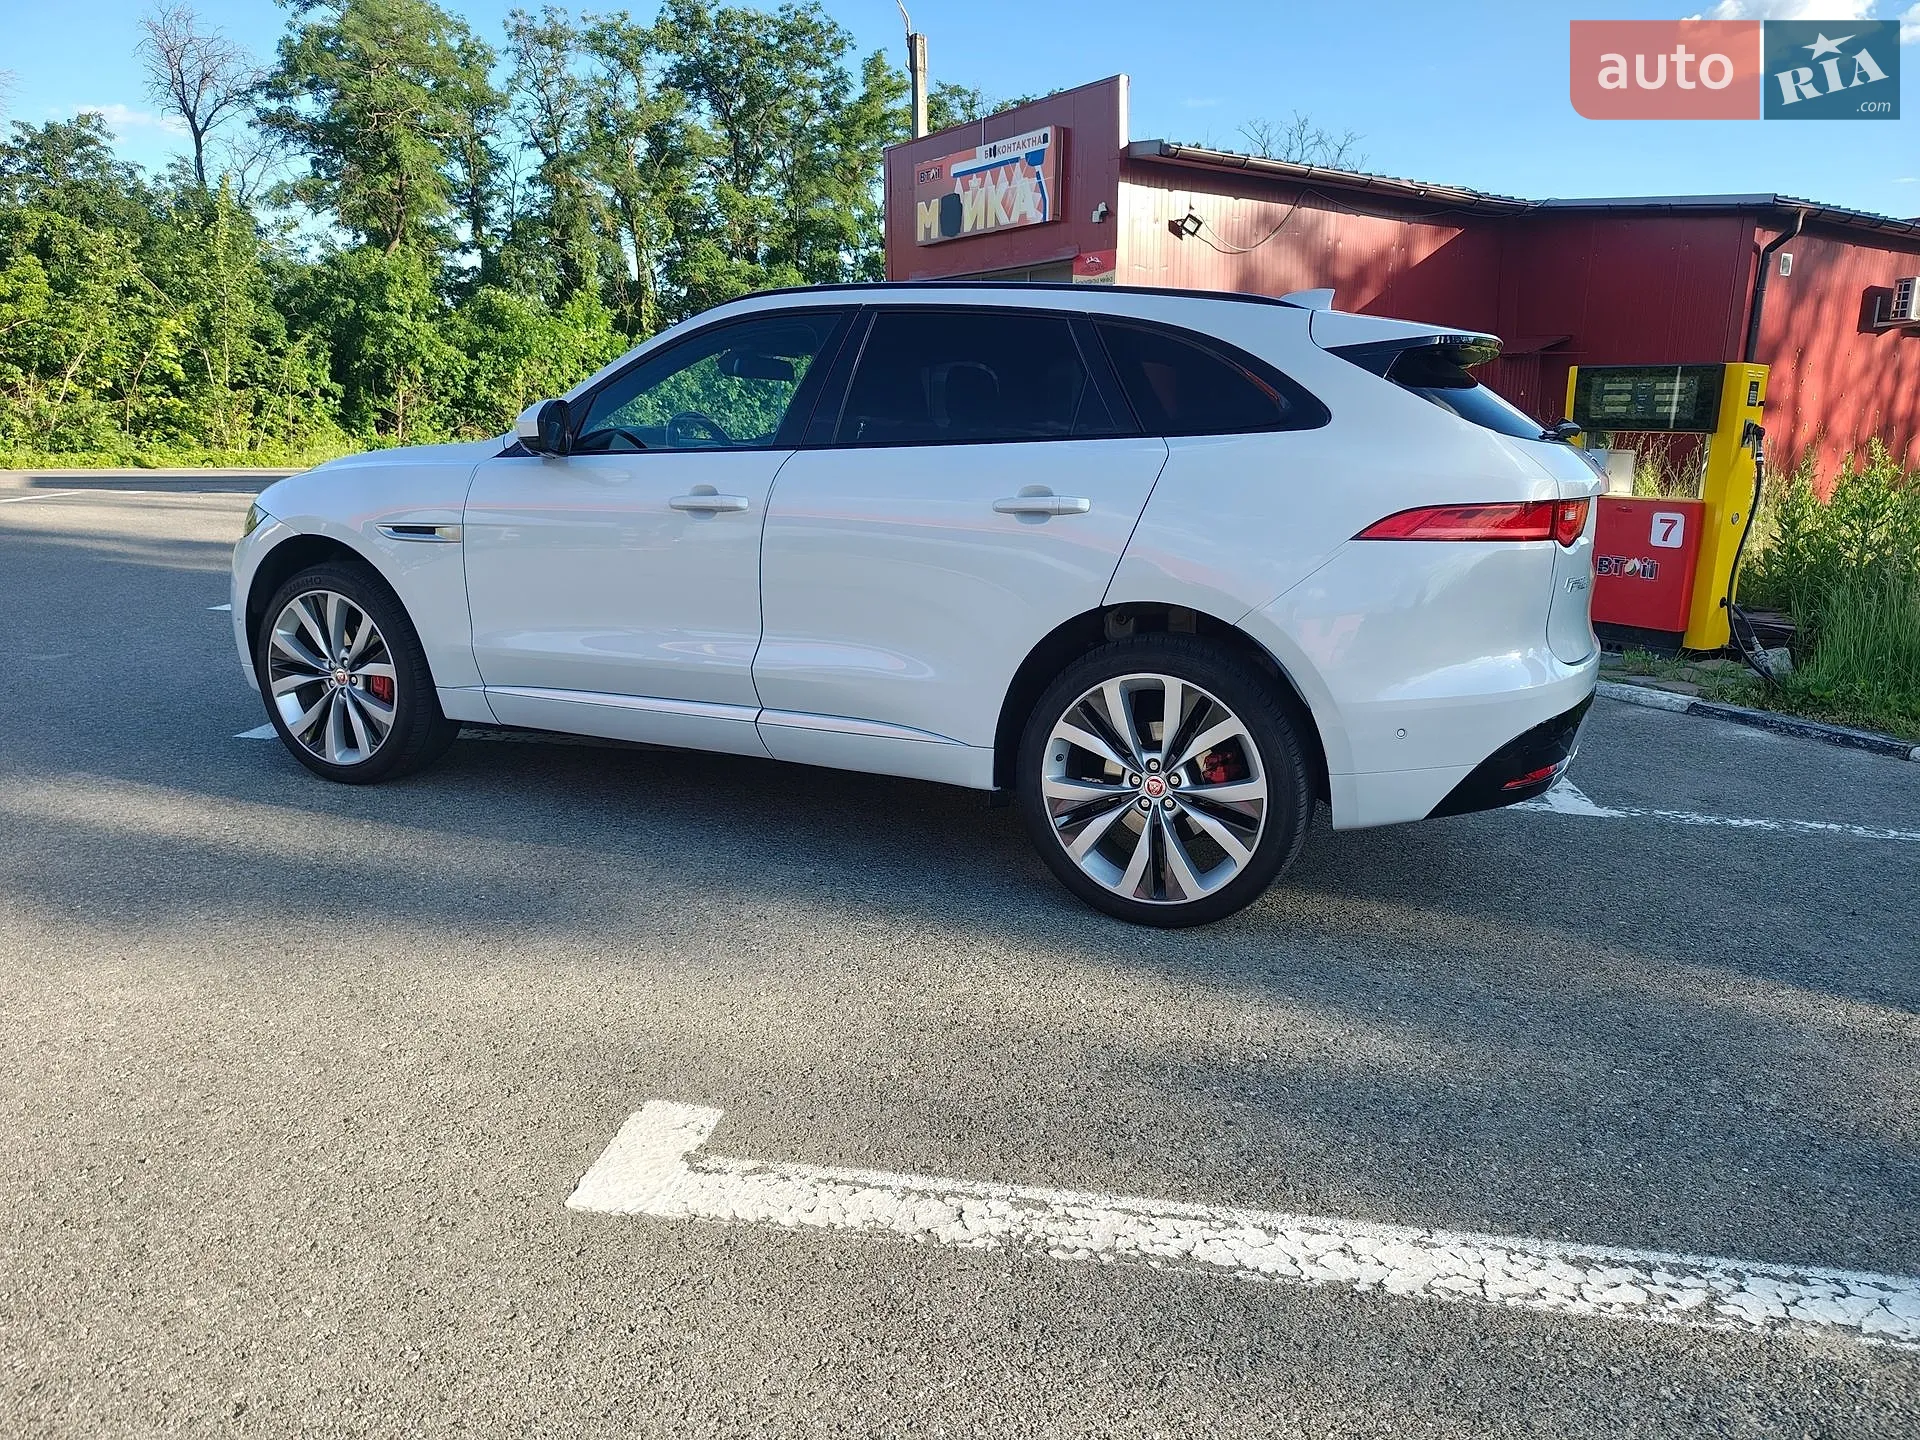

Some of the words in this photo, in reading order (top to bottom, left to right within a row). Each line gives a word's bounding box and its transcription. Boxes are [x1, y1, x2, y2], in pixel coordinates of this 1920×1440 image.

[984, 132, 1049, 160] БКОНТАКТНА
[917, 176, 1037, 242] МЙКА
[1659, 518, 1678, 542] 7
